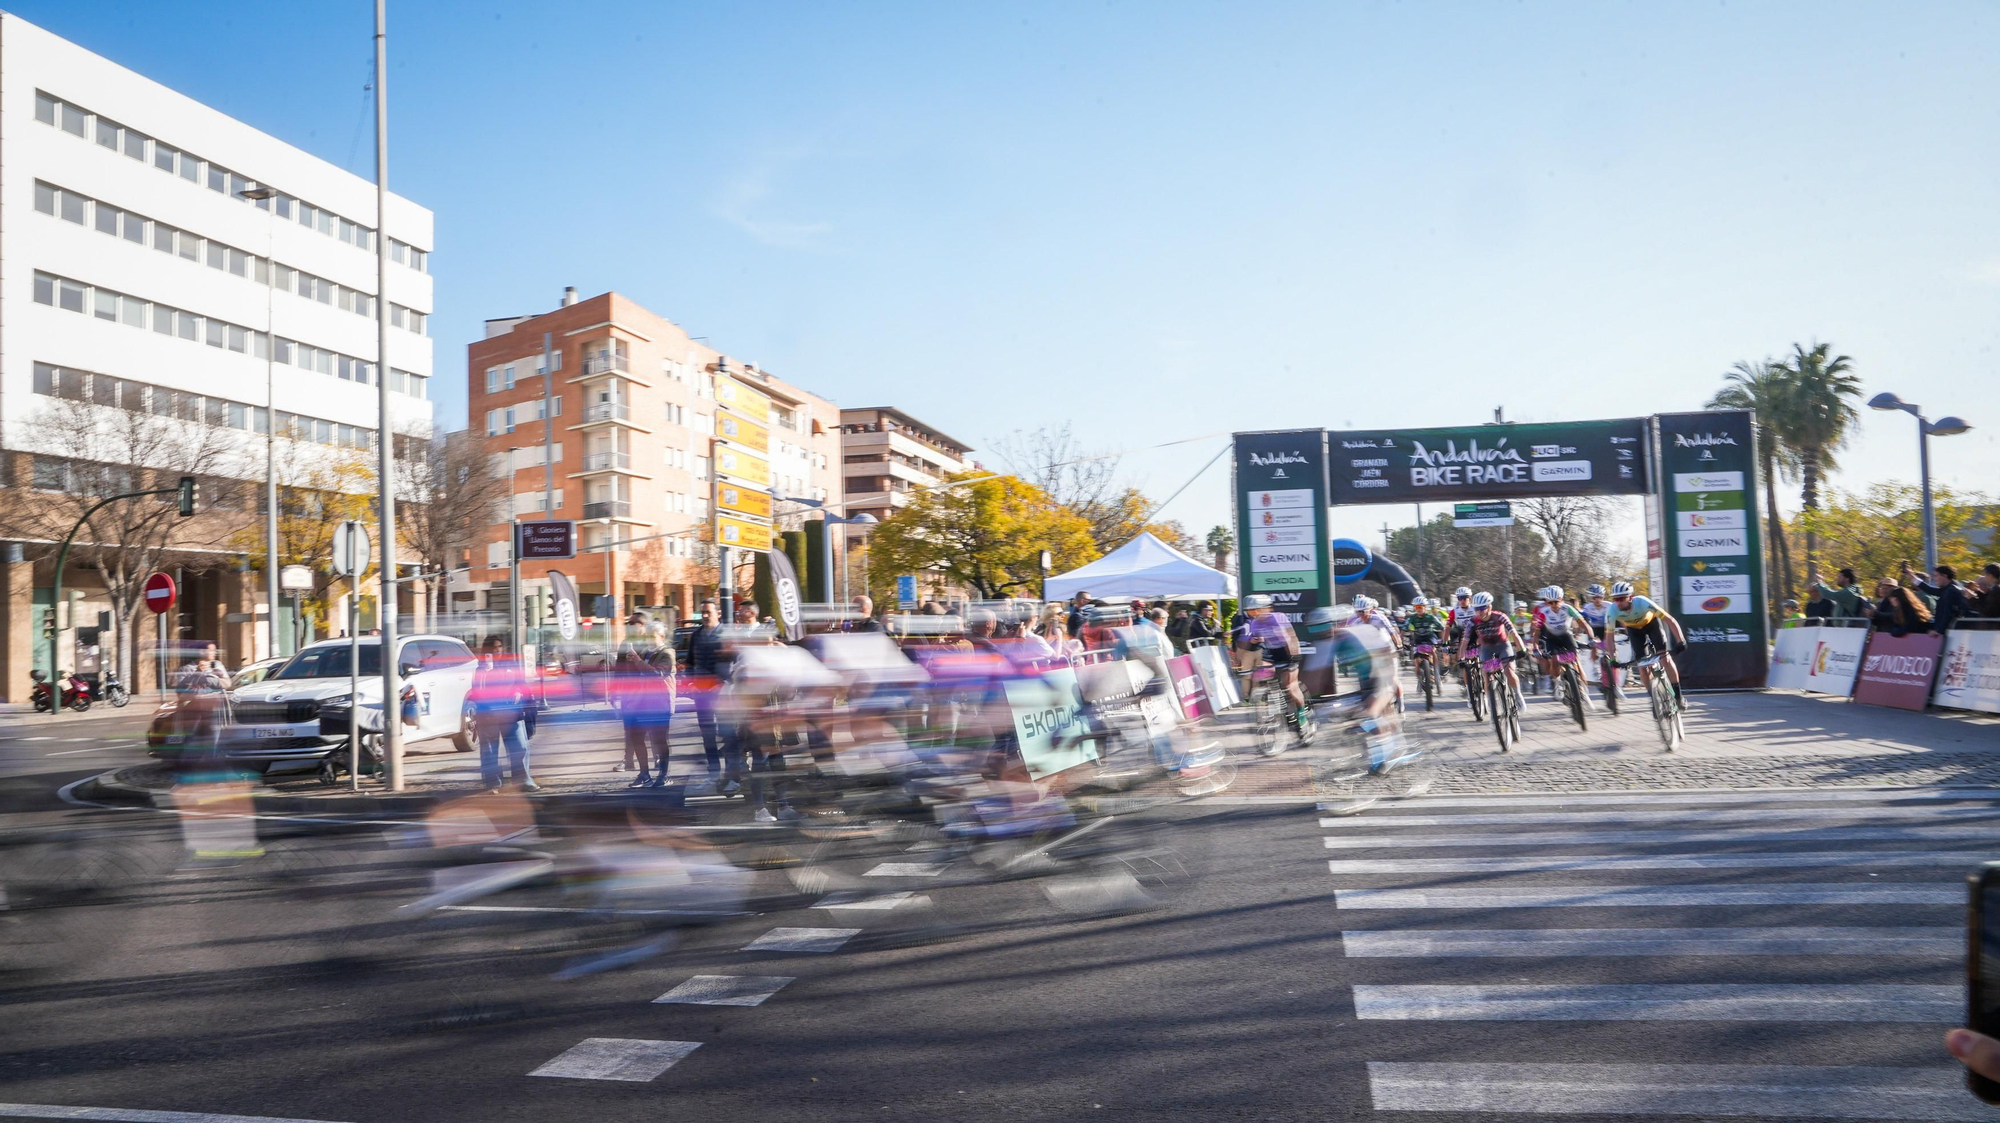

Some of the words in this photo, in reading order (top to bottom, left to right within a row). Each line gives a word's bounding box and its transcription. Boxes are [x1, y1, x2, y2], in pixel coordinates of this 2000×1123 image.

[1674, 431, 1738, 448] Andalucía
[1408, 437, 1528, 467] Andalucía
[1537, 447, 1559, 456] UCI
[1249, 451, 1309, 466] Andalucía
[1351, 459, 1389, 467] GRANADA
[1410, 466, 1462, 487] BIKE
[1465, 463, 1530, 485] RACE
[1540, 467, 1586, 476] GARMIN
[1351, 478, 1390, 488] CÓRDOBA
[1686, 539, 1740, 548] GARMIN
[1260, 554, 1310, 563] GARMIN
[1878, 655, 1932, 676] IMDECO
